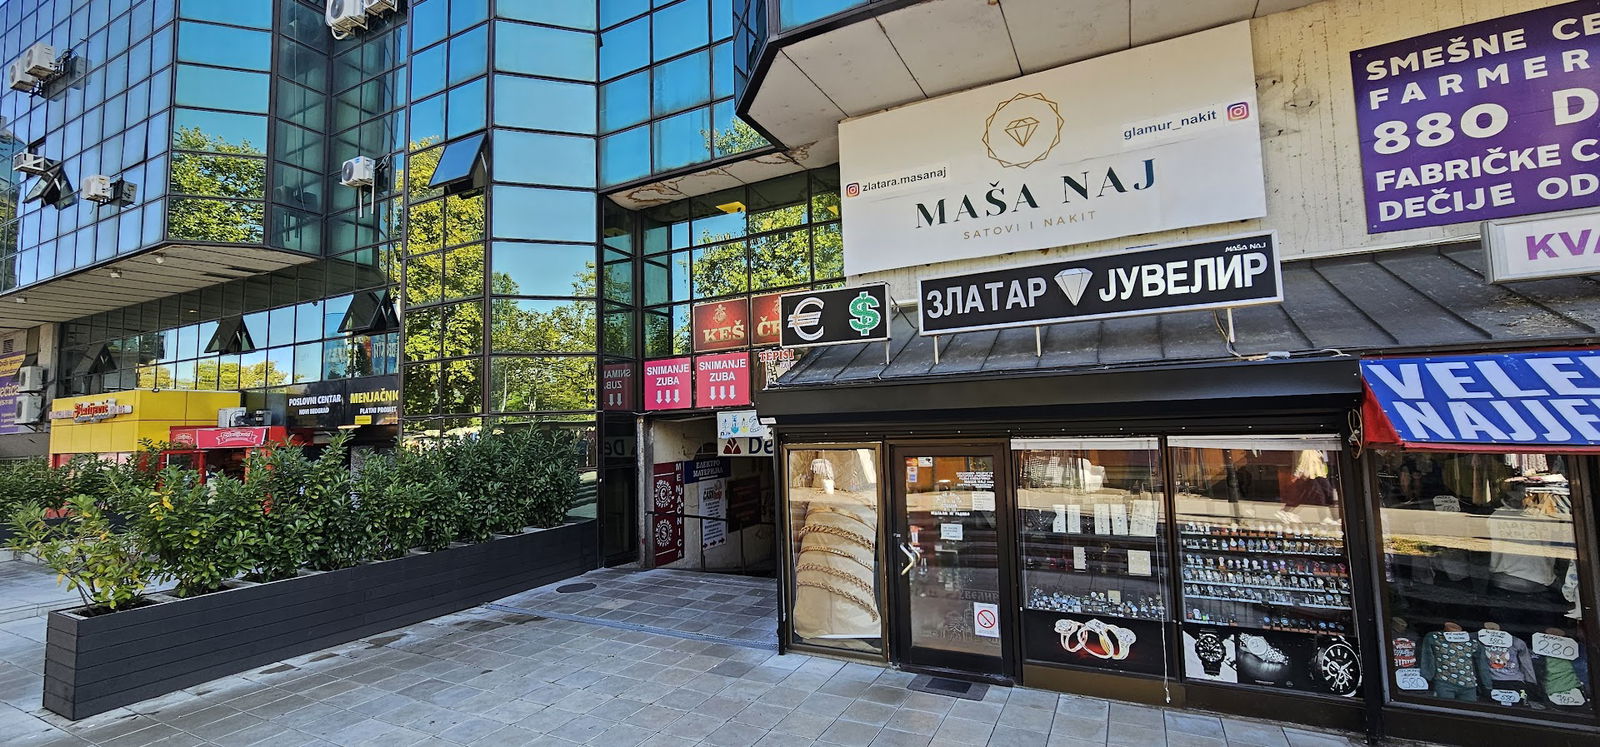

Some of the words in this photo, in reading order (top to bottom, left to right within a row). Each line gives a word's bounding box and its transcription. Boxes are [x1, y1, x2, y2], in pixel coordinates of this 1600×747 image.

[1366, 28, 1527, 81] SMEŠNE
[1369, 48, 1591, 110] FARMER
[1123, 110, 1218, 141] glamur_nakit
[1373, 103, 1509, 155] 880
[1552, 87, 1599, 126] D
[1376, 143, 1562, 192] FABRIČKE
[1572, 138, 1600, 163] C
[862, 167, 947, 193] zlatara.masanaj
[915, 180, 1040, 229] MAŠA
[1062, 158, 1157, 204] NAJ
[1378, 182, 1516, 222] DEČIJE
[1537, 172, 1600, 200] OD
[963, 223, 1020, 240] SATOVI
[1029, 220, 1034, 230] I
[1044, 209, 1098, 228] NAKIT
[926, 277, 1047, 319] ЗЛАТАР
[1099, 252, 1268, 302] ЈУВЕЛИР
[703, 319, 745, 343] KEŠ
[646, 362, 690, 376] SNIMANJE
[699, 358, 746, 371] SNIMANJE
[709, 371, 736, 382] ZUBA
[656, 376, 680, 387] ZUBA
[289, 395, 317, 406] POSLOVNI
[317, 394, 342, 404] CENTAR
[748, 436, 773, 455] De
[1538, 639, 1575, 656] 280
[1401, 677, 1425, 688] 580
